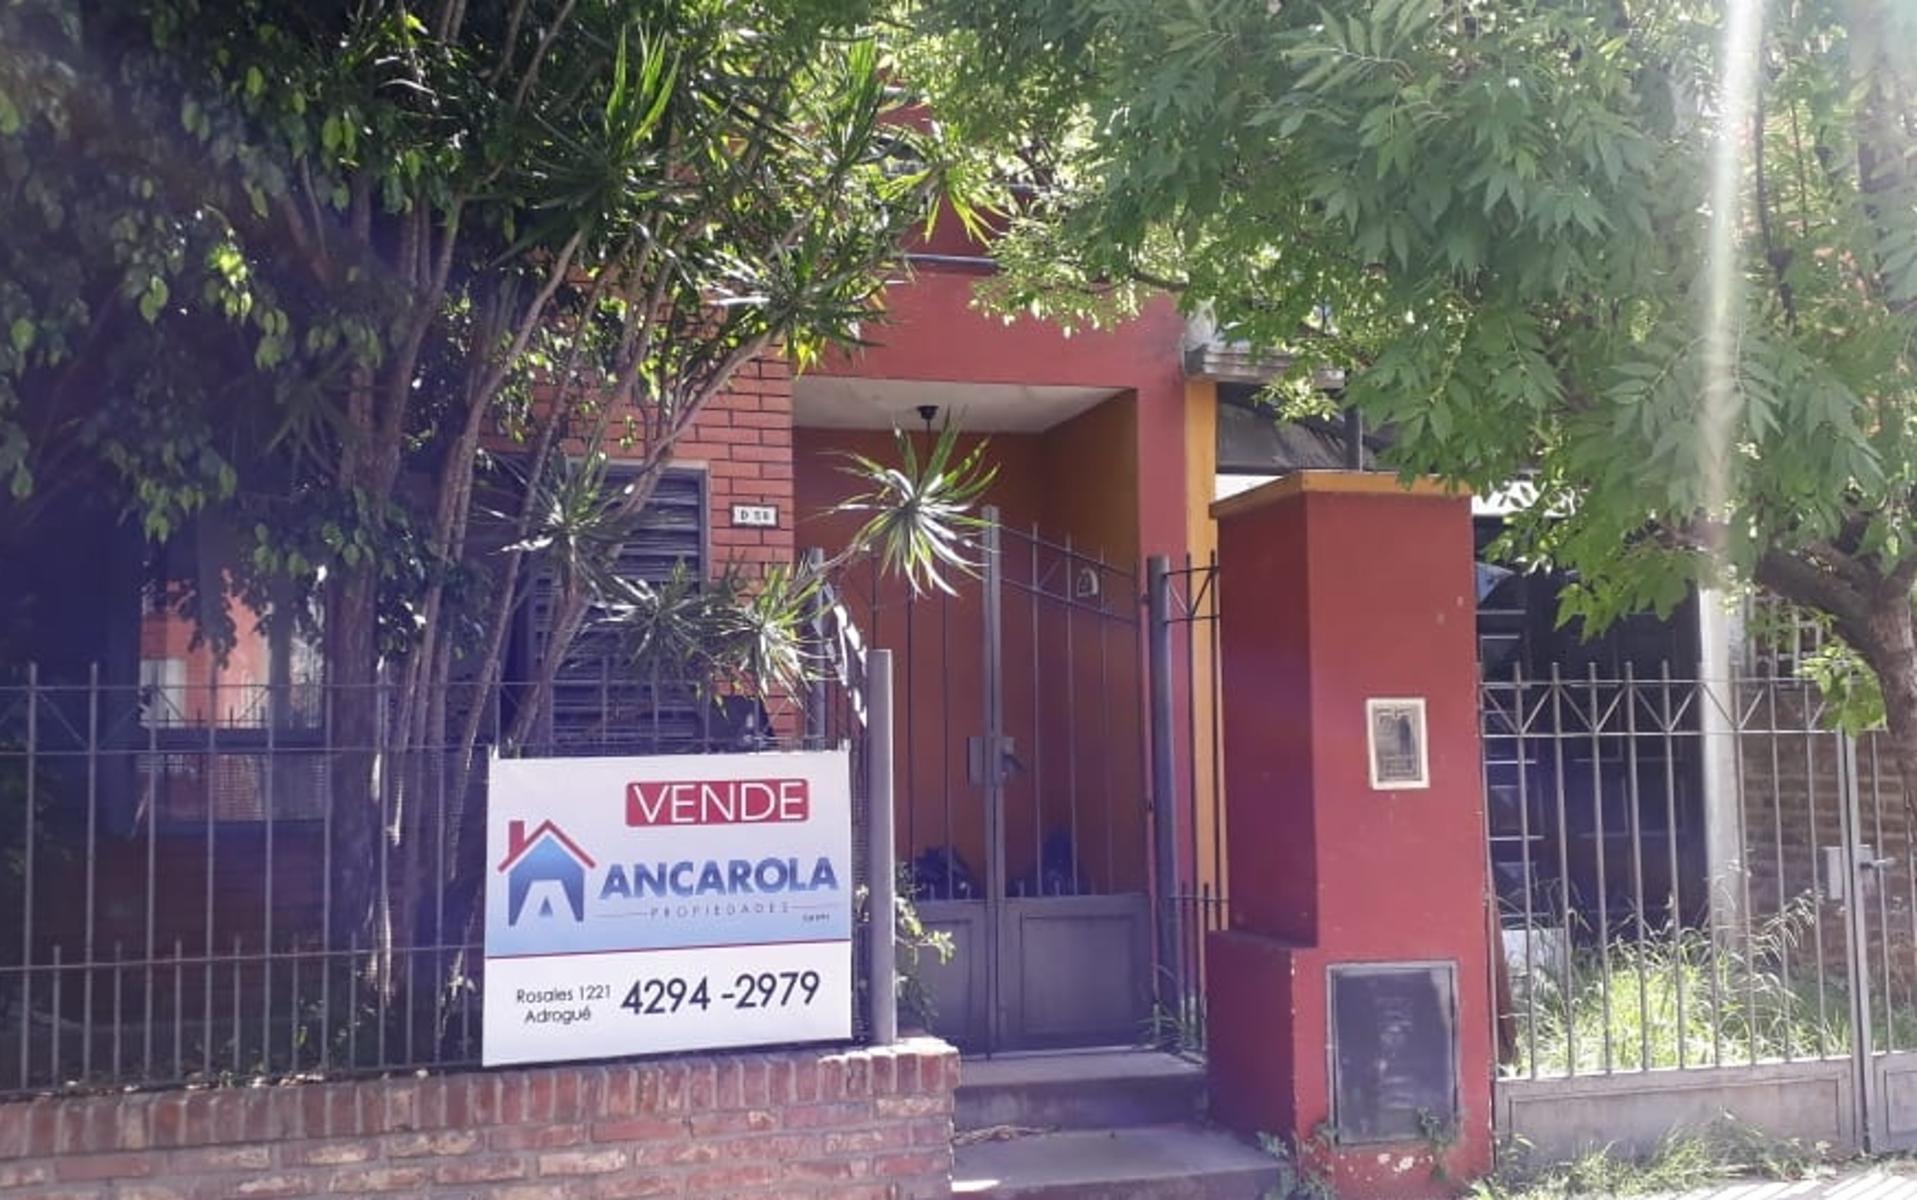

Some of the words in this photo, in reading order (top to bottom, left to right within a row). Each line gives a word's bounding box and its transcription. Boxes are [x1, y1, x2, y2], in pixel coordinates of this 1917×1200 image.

[633, 781, 804, 823] VENDE
[600, 857, 839, 900] ANCAROLA
[650, 901, 790, 919] PROPIEDADES
[516, 987, 574, 1004] Rosales
[580, 984, 611, 1001] 1221
[620, 976, 712, 1015] 4294
[524, 1005, 592, 1025] Adrogué
